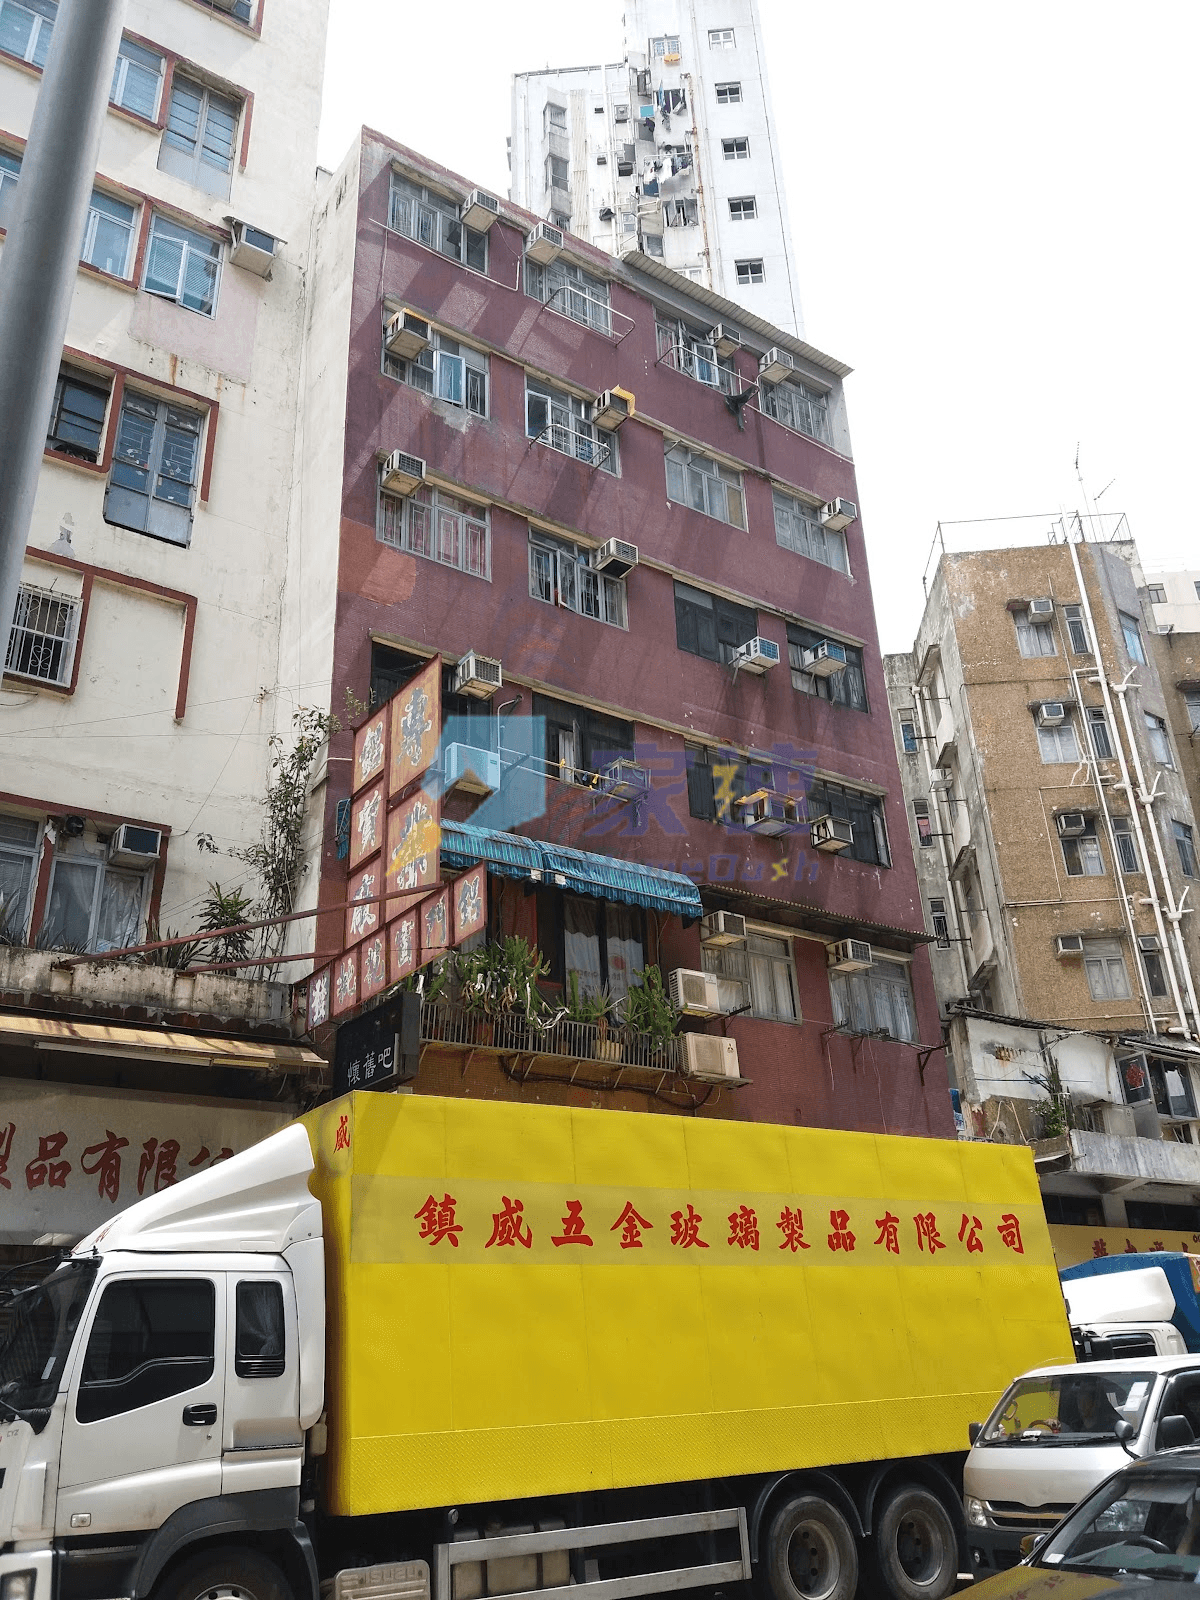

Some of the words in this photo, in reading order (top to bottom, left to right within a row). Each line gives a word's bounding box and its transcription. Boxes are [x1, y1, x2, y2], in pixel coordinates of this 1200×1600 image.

[347, 1046, 394, 1087] 懷舊吧
[333, 1115, 351, 1154] 威
[413, 1192, 1026, 1256] 鎮威五金玻璃製品有限公司
[364, 1565, 418, 1584] ISUZU
